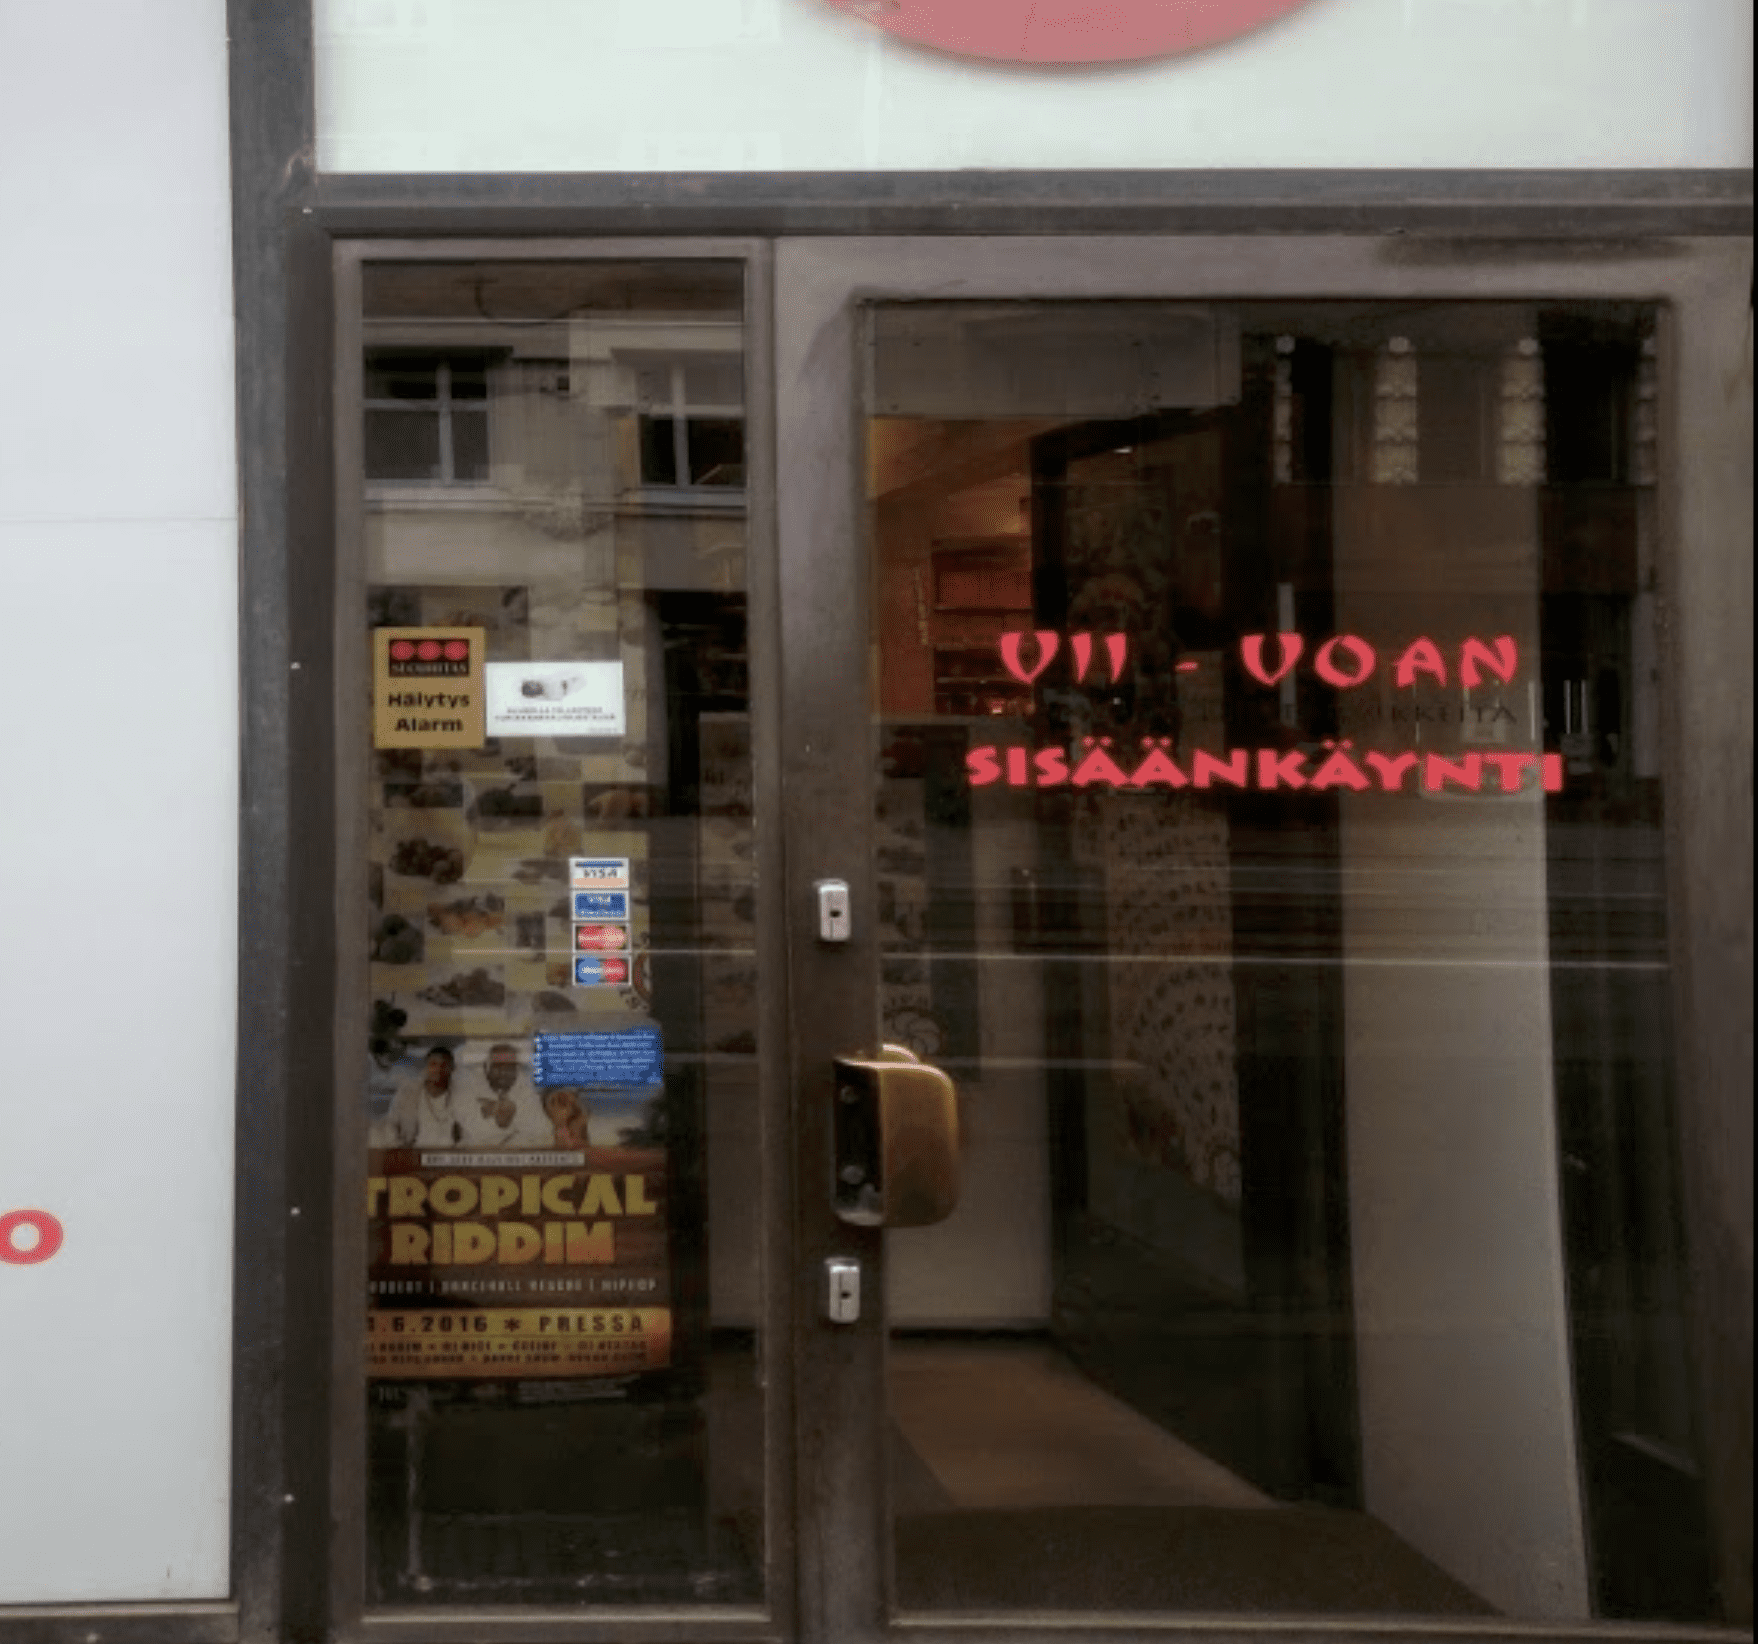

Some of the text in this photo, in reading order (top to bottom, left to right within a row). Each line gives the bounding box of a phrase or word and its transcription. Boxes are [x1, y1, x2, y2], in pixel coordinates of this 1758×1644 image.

[1000, 631, 1127, 684] VII
[1241, 633, 1517, 687] VOAN
[389, 691, 470, 708] Hälytys
[395, 717, 463, 732] Alarm
[965, 736, 1563, 792] SISÄÄNKÄYNTI
[367, 1174, 656, 1217] TROPICAL
[391, 1222, 614, 1264] RIDDIM
[539, 1315, 643, 1333] PRESSA
